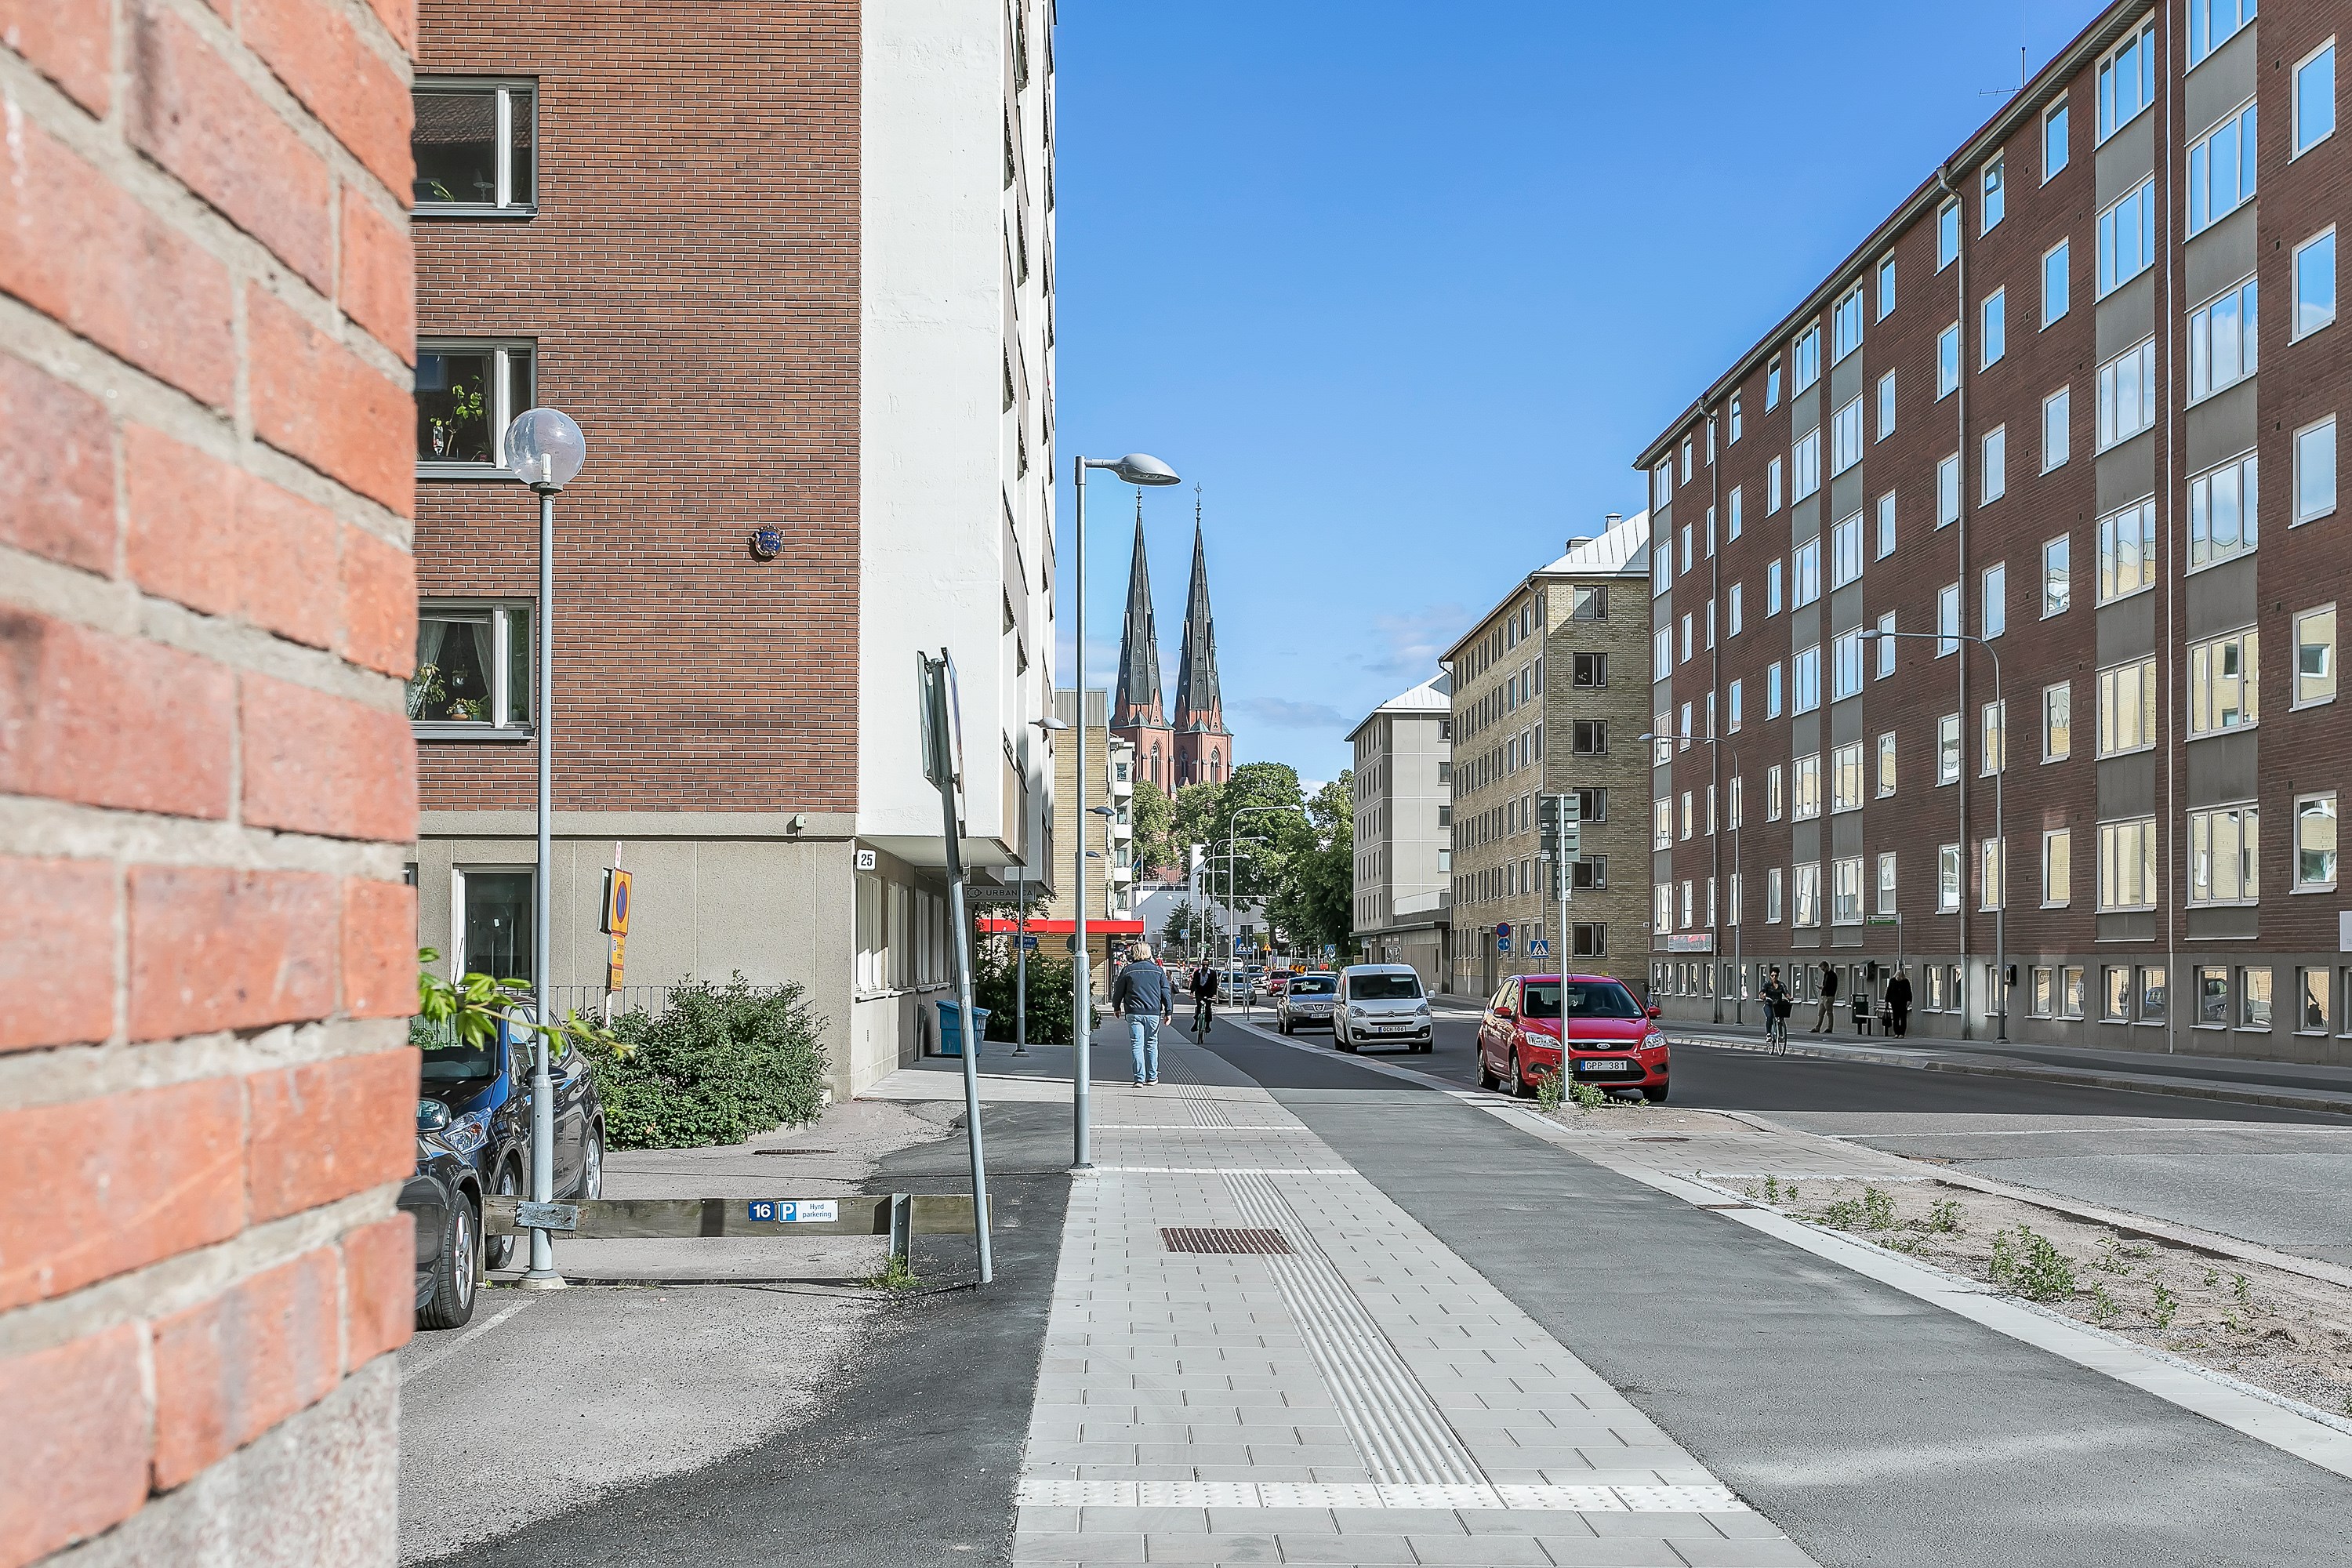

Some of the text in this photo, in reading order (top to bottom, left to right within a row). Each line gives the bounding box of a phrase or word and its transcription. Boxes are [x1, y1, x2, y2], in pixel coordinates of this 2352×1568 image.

[861, 853, 873, 866] 25
[753, 1203, 771, 1218] 16
[782, 1203, 795, 1220] P
